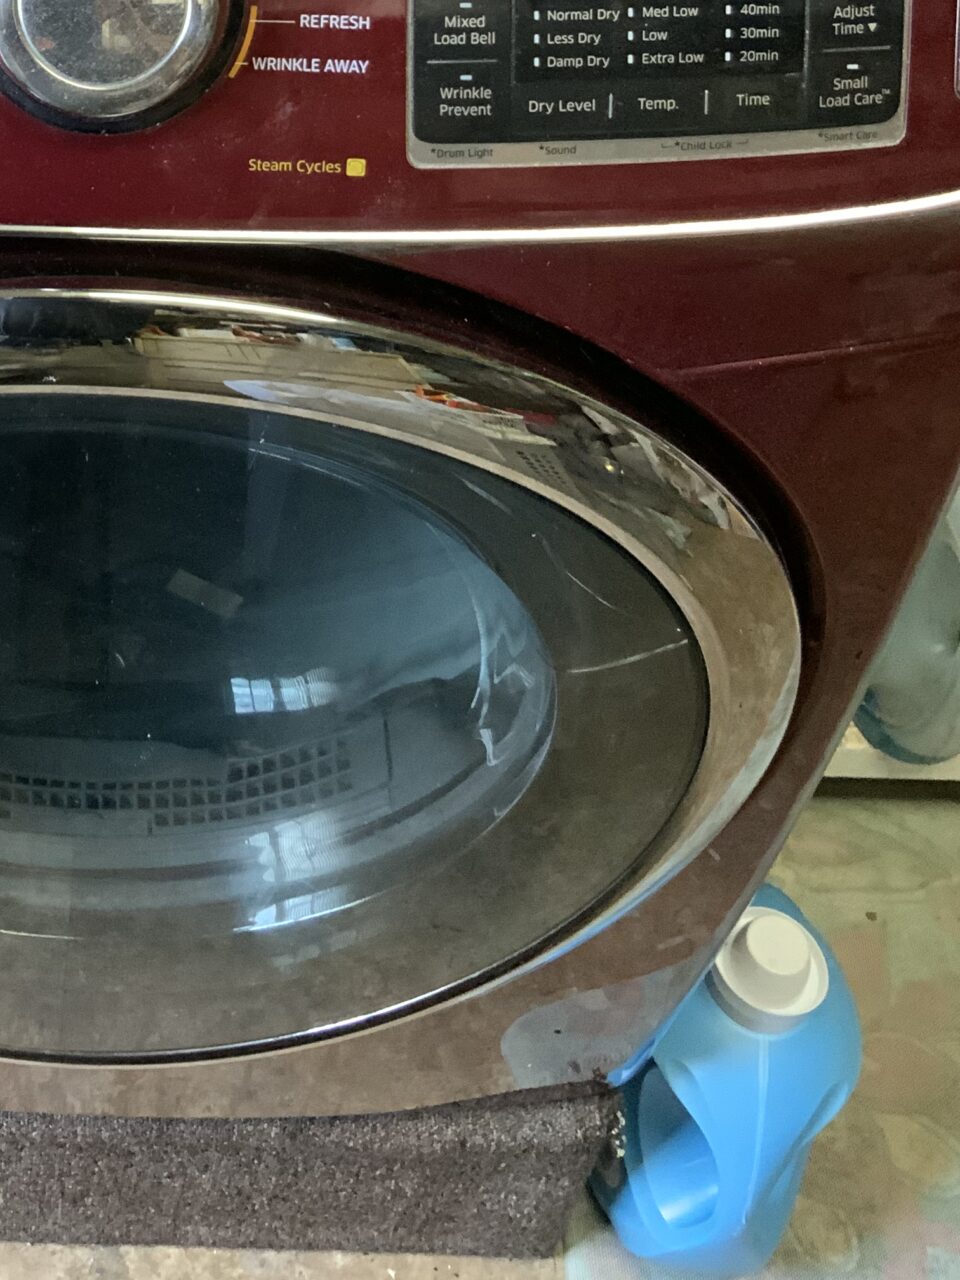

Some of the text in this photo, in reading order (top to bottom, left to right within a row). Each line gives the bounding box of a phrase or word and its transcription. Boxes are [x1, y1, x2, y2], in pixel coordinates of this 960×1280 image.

[547, 9, 621, 22] Normal Dry
[642, 6, 699, 18] Med Low
[740, 3, 780, 16] 40min
[833, 4, 875, 19] Adjust
[299, 14, 370, 30] REFRESH
[444, 15, 486, 28] Mixed
[740, 27, 780, 39] 30min
[832, 22, 865, 35] Time
[434, 31, 496, 45] Load Bell
[547, 33, 601, 45] Less Dry
[642, 30, 668, 41] Low
[547, 56, 610, 69] Damp Dry
[641, 52, 705, 64] Extra Low
[740, 50, 779, 62] 20min
[252, 57, 369, 75] WRINKLE AWAY
[833, 76, 868, 90] Small
[439, 87, 492, 100] Wrinkle
[528, 99, 596, 114] Dry Level
[638, 98, 679, 112] Temp.
[736, 94, 770, 107] Time
[819, 95, 850, 108] Load
[439, 103, 492, 117] Prevent
[856, 129, 878, 140] Care
[709, 139, 732, 150] Lock
[467, 147, 494, 159] Light
[248, 158, 341, 176] Steam Cycles
